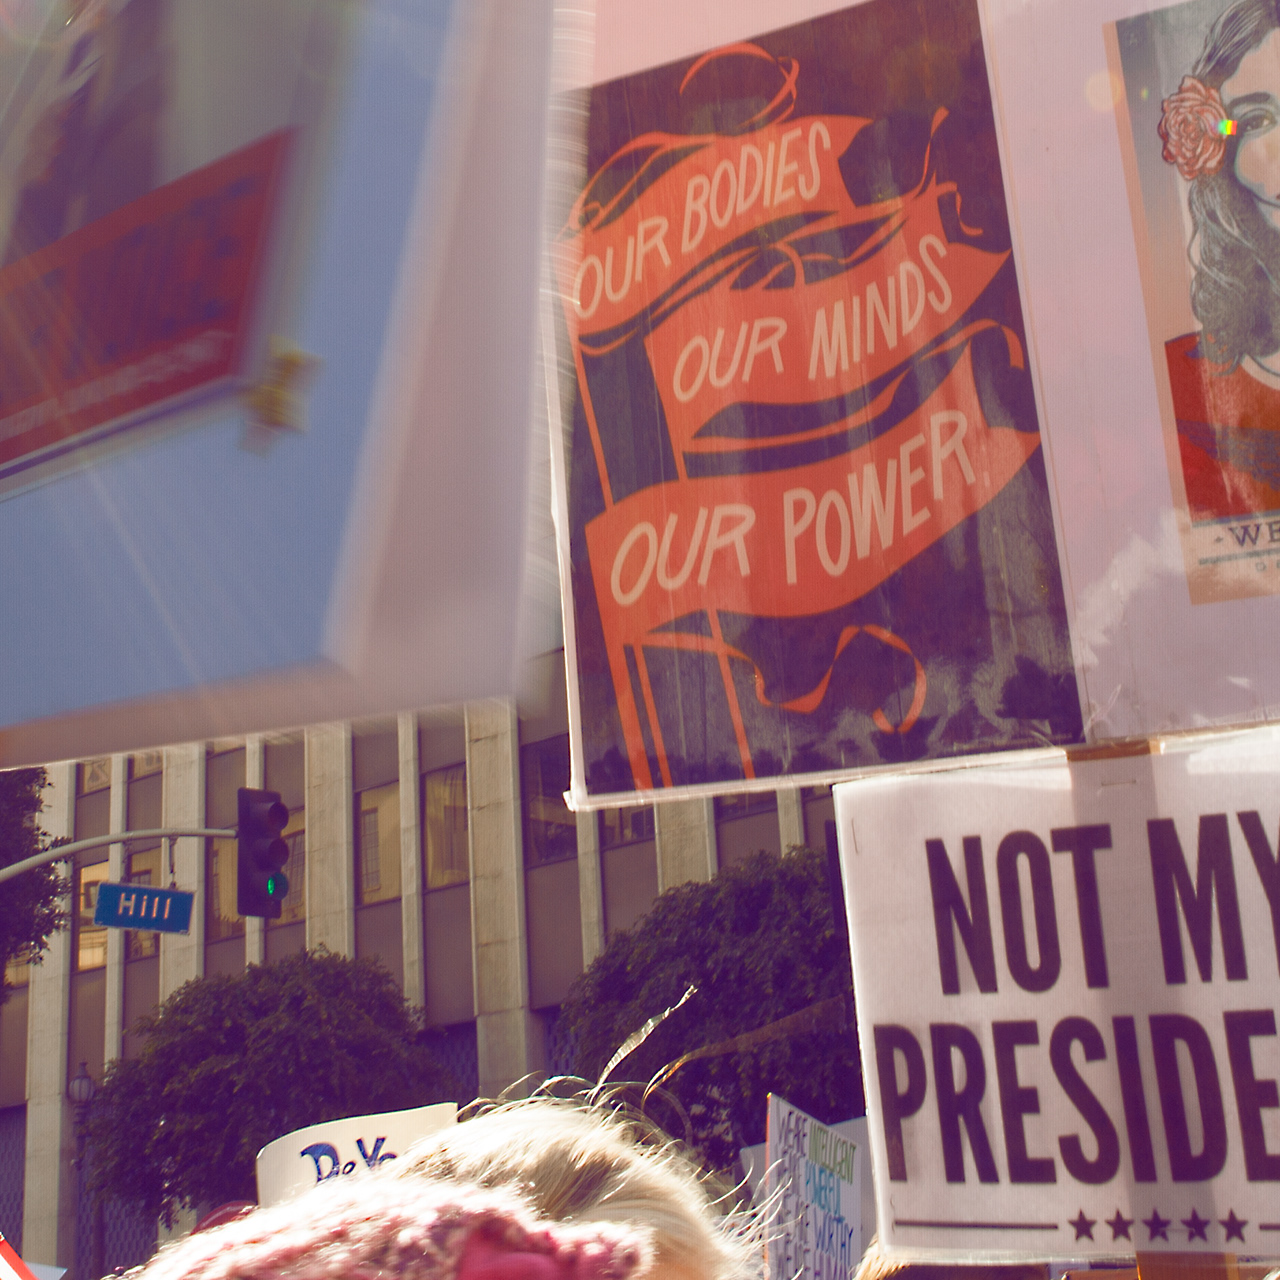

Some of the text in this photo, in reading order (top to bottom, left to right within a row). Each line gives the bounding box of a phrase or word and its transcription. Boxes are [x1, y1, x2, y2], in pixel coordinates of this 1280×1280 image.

[573, 120, 832, 319] OUR BODIES
[672, 232, 954, 404] OUR MINDS
[610, 408, 977, 607] OUR POWER
[118, 892, 172, 920] Hill
[924, 822, 1114, 996] NOT
